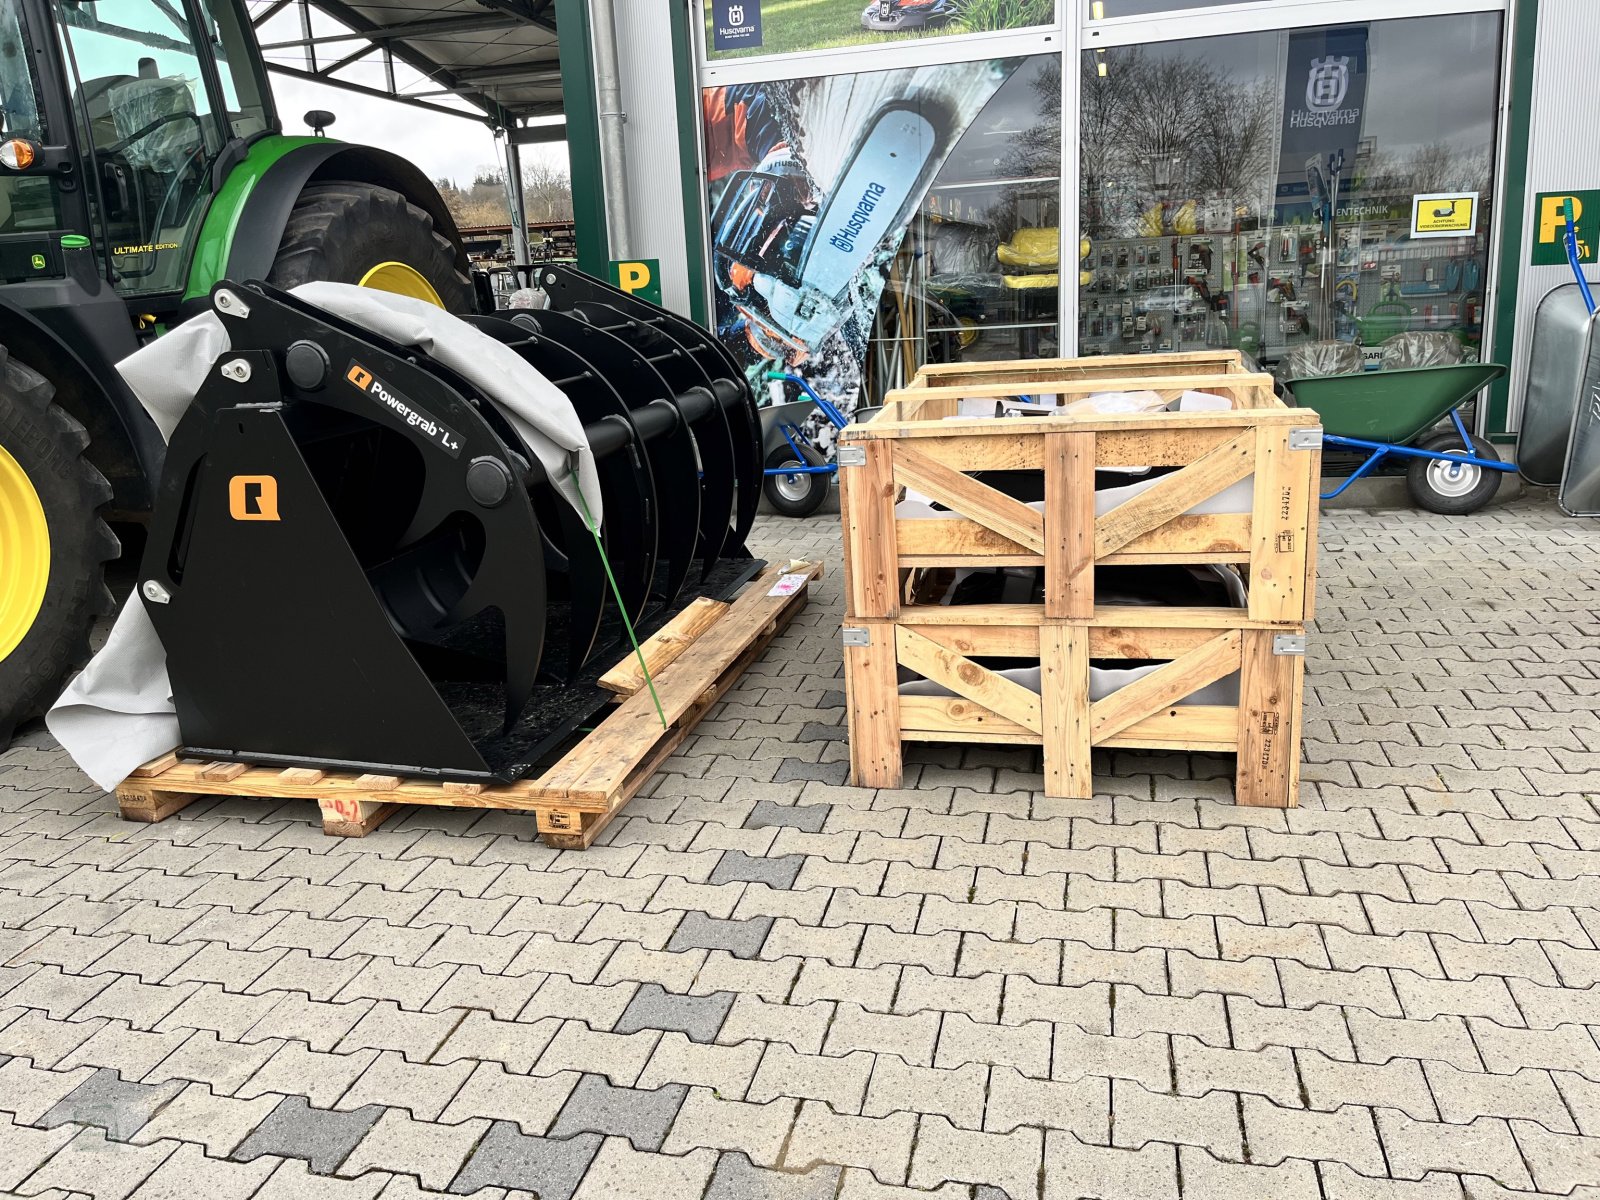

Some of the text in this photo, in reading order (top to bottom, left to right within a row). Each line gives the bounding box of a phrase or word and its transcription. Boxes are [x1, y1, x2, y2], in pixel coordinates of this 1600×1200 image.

[719, 26, 755, 36] Husqvarna
[836, 181, 887, 243] Husqvarna
[1539, 195, 1583, 244] P
[114, 245, 154, 255] ULTIMATE
[618, 262, 651, 295] P
[441, 432, 459, 450] L+
